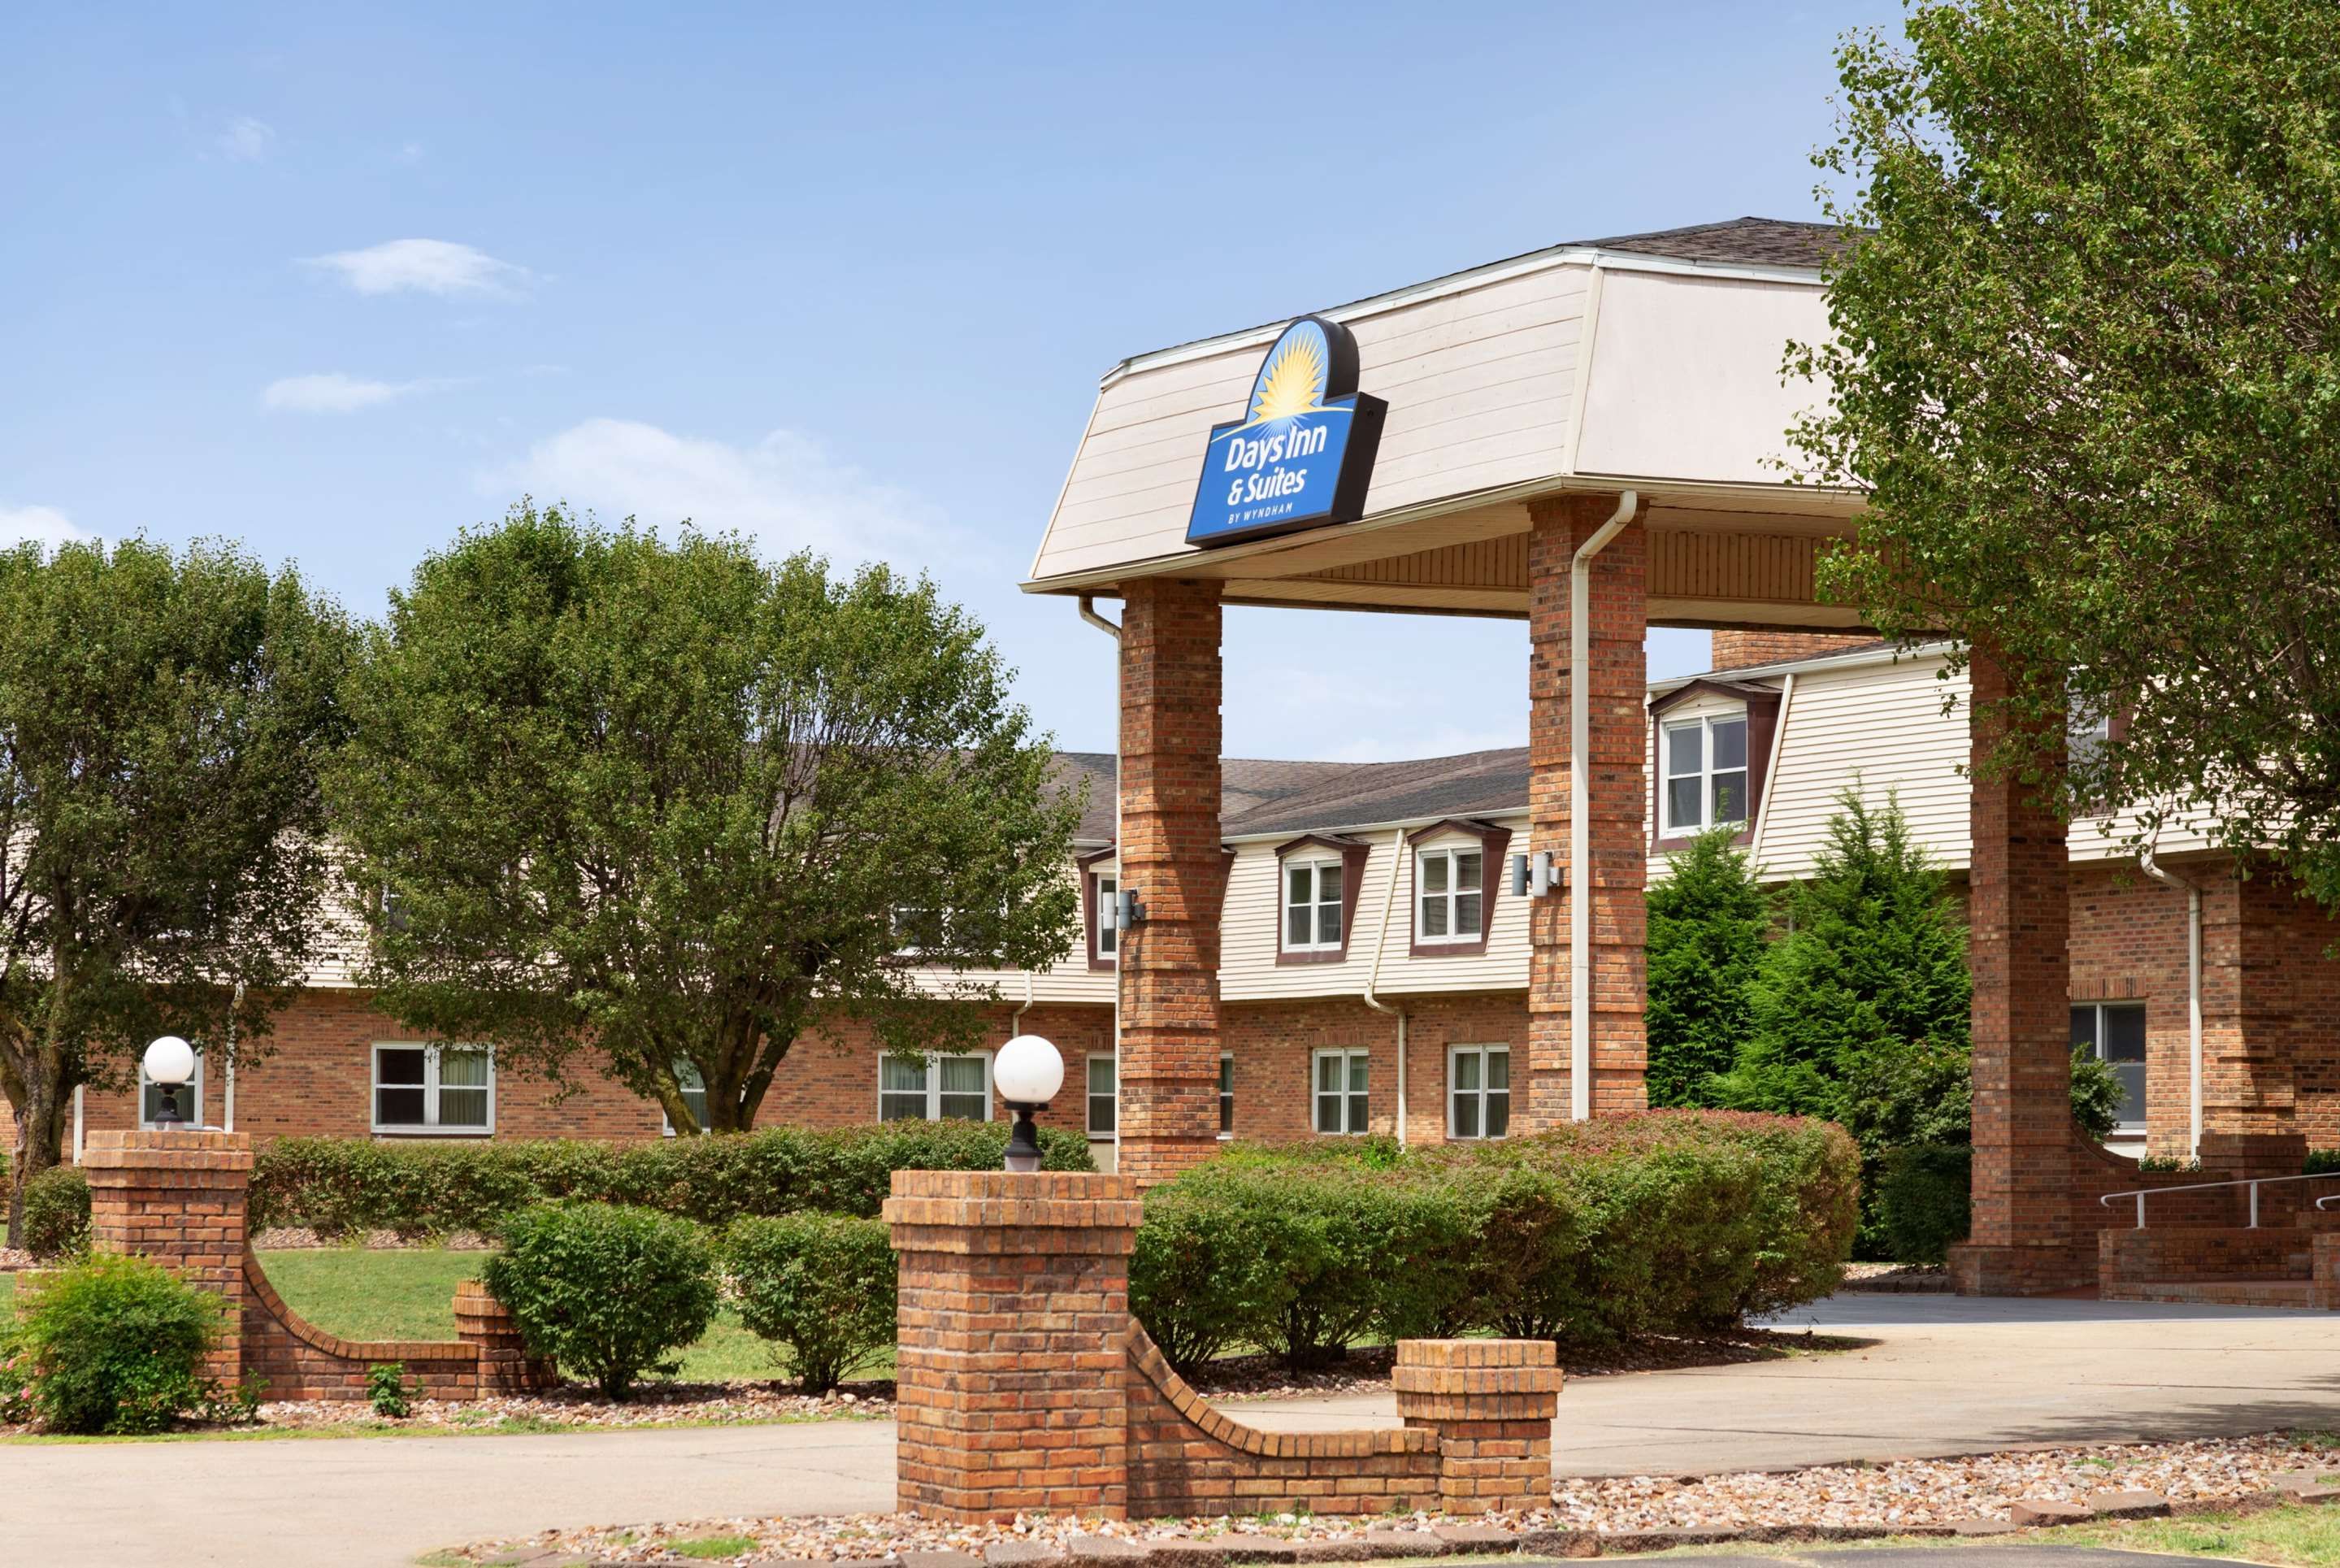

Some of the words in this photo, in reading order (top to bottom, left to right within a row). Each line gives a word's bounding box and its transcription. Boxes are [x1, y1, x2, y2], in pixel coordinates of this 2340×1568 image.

[1224, 433, 1285, 472] Days
[1285, 425, 1327, 460] Inn
[1227, 479, 1244, 506] &
[1244, 467, 1307, 503] Suites
[1228, 512, 1240, 524] BY
[1244, 502, 1293, 522] WYNDHAM
